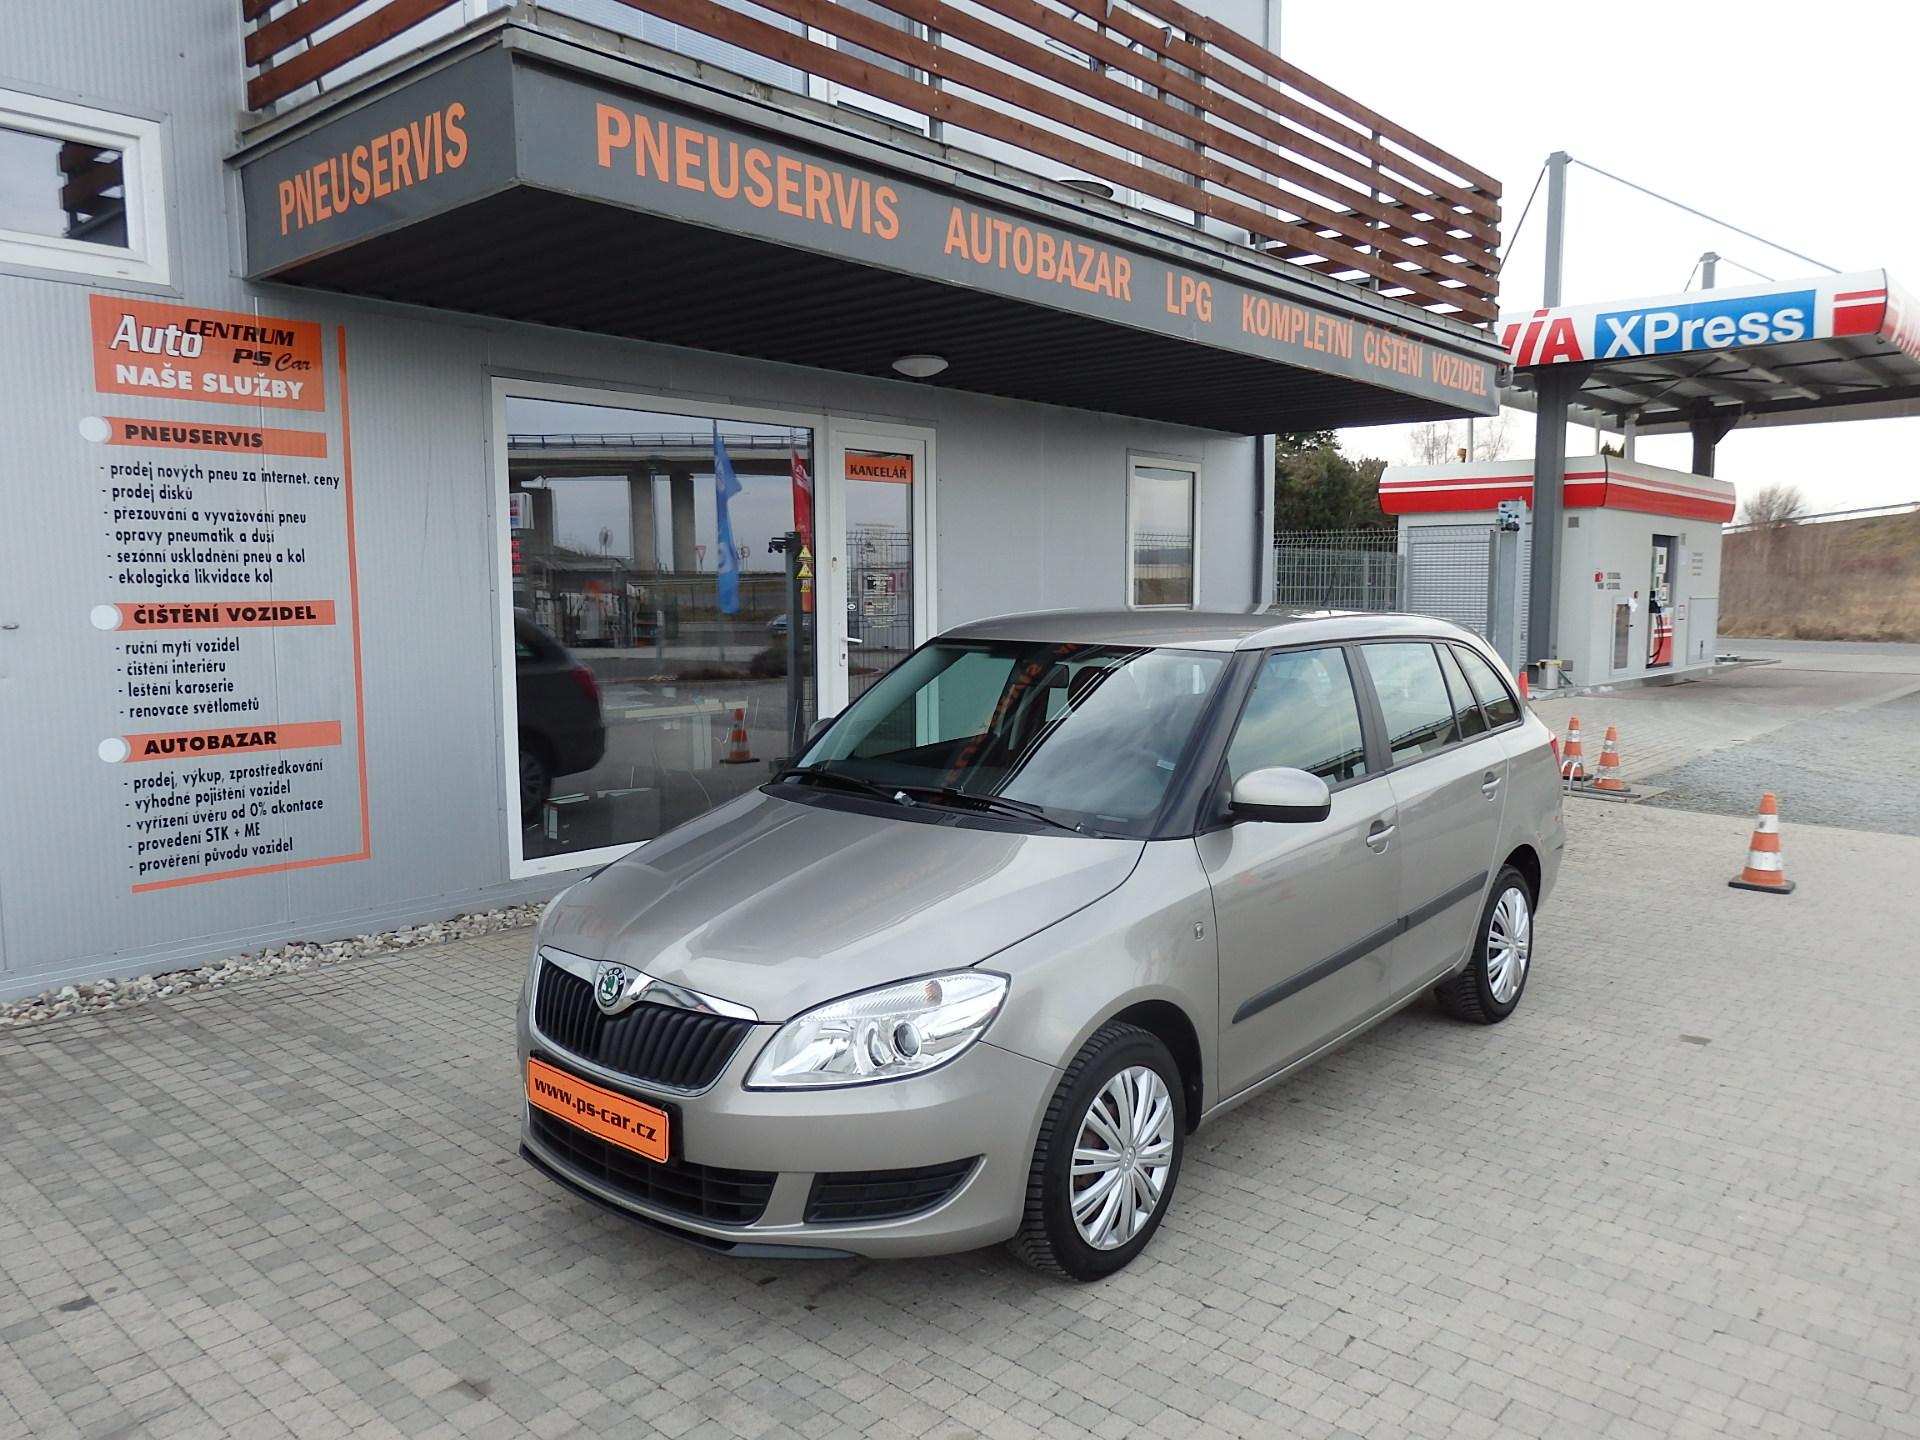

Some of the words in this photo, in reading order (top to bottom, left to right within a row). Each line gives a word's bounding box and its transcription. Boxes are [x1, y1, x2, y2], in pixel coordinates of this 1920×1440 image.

[279, 102, 468, 236] PNEUSERVIS
[595, 102, 899, 240] PNEUSERVIS
[944, 207, 1132, 302] AUTOBAZAR
[1166, 271, 1212, 323] LPG
[1241, 293, 1356, 359] KOMPLETNÍ
[1363, 320, 1425, 378] ČIŠTĚNÍ
[1432, 352, 1487, 396] VOZIDEL
[109, 313, 204, 359] Auto
[185, 318, 295, 347] CENTRUM
[1604, 307, 1805, 357] XPress
[232, 348, 273, 367] PS
[274, 352, 313, 372] Car
[116, 362, 193, 390] NAŠE
[202, 371, 304, 400] SLUŽBY
[124, 423, 264, 448] PNEUSERVIS
[111, 461, 153, 480] prodej
[157, 463, 203, 482] nových
[208, 468, 238, 483] pneu
[242, 470, 257, 482] za
[261, 467, 311, 485] internet.
[313, 475, 340, 489] ceny
[850, 463, 907, 479] KANCELÁŘ
[112, 483, 155, 503] prodej
[114, 506, 187, 523] přezouvání
[191, 511, 199, 521] a
[204, 508, 275, 525] vyvažování
[279, 512, 307, 526] pneu
[115, 530, 162, 545] opravy
[168, 527, 235, 545] pneumatik
[239, 532, 247, 543] a
[251, 528, 275, 544] duší
[117, 549, 166, 563] sezónní
[171, 547, 239, 563] uskladnění
[243, 552, 272, 566] pneu
[276, 552, 283, 563] a
[288, 548, 305, 563] kol
[119, 568, 190, 588] ekologická
[195, 568, 251, 584] likvidace
[255, 568, 273, 584] kol
[133, 603, 220, 624] ČIŠTĚNÍ
[228, 606, 317, 622] VOZIDEL
[125, 640, 158, 655] ruční
[196, 636, 240, 652] vozidel
[127, 661, 168, 676] čištění
[172, 658, 226, 674] interiéru
[128, 681, 171, 697] leštění
[175, 678, 234, 695] karoserie
[129, 703, 189, 718] renovace
[193, 697, 260, 714] světlometů
[144, 731, 277, 755] AUTOBAZAR
[134, 771, 178, 793] prodej,
[183, 767, 225, 787] výkup,
[229, 758, 323, 780] zprostředkování
[195, 786, 245, 806] pojištění
[249, 779, 291, 797] vozidel
[136, 814, 189, 834] vyřízení
[193, 808, 227, 824] úvěru
[231, 804, 246, 819] od
[250, 801, 267, 817] 0%
[271, 799, 324, 814] akontace
[138, 832, 202, 855] provedení
[206, 826, 230, 843] STK
[139, 854, 201, 875] prověření
[205, 847, 248, 866] původu
[252, 837, 293, 856] vozidel
[534, 1077, 657, 1143] www.ps-car.cz
